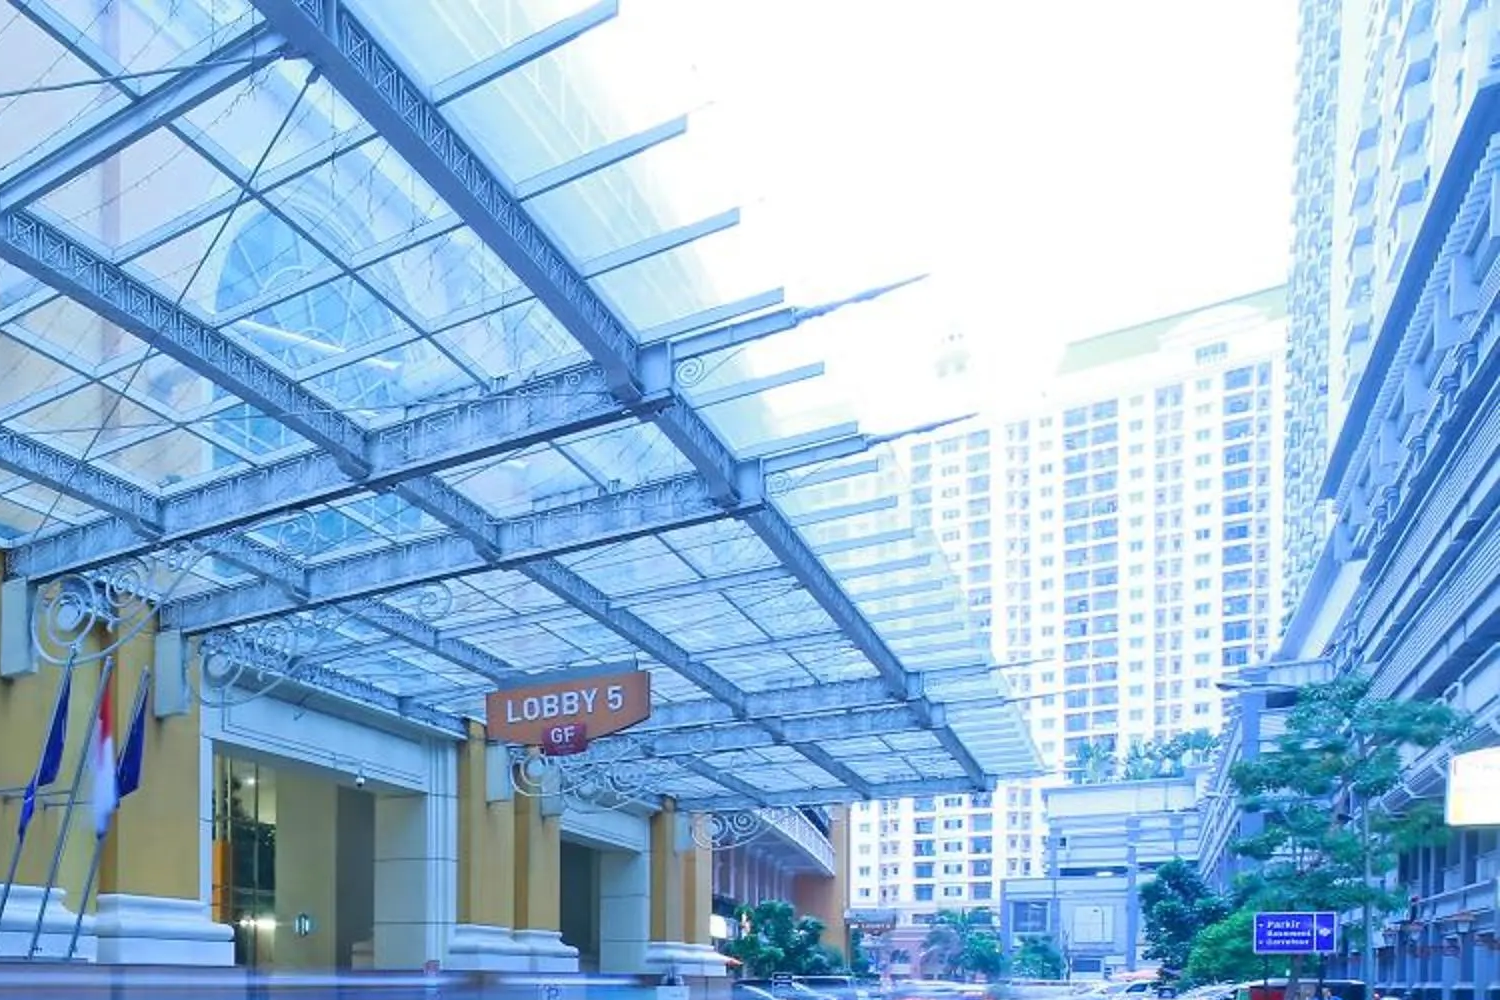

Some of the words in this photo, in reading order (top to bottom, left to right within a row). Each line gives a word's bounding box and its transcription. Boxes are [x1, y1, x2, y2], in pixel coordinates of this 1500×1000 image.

[506, 687, 598, 724] LOBBY
[607, 685, 624, 711] 5
[551, 726, 575, 743] GF
[1267, 920, 1301, 929] Parkir
